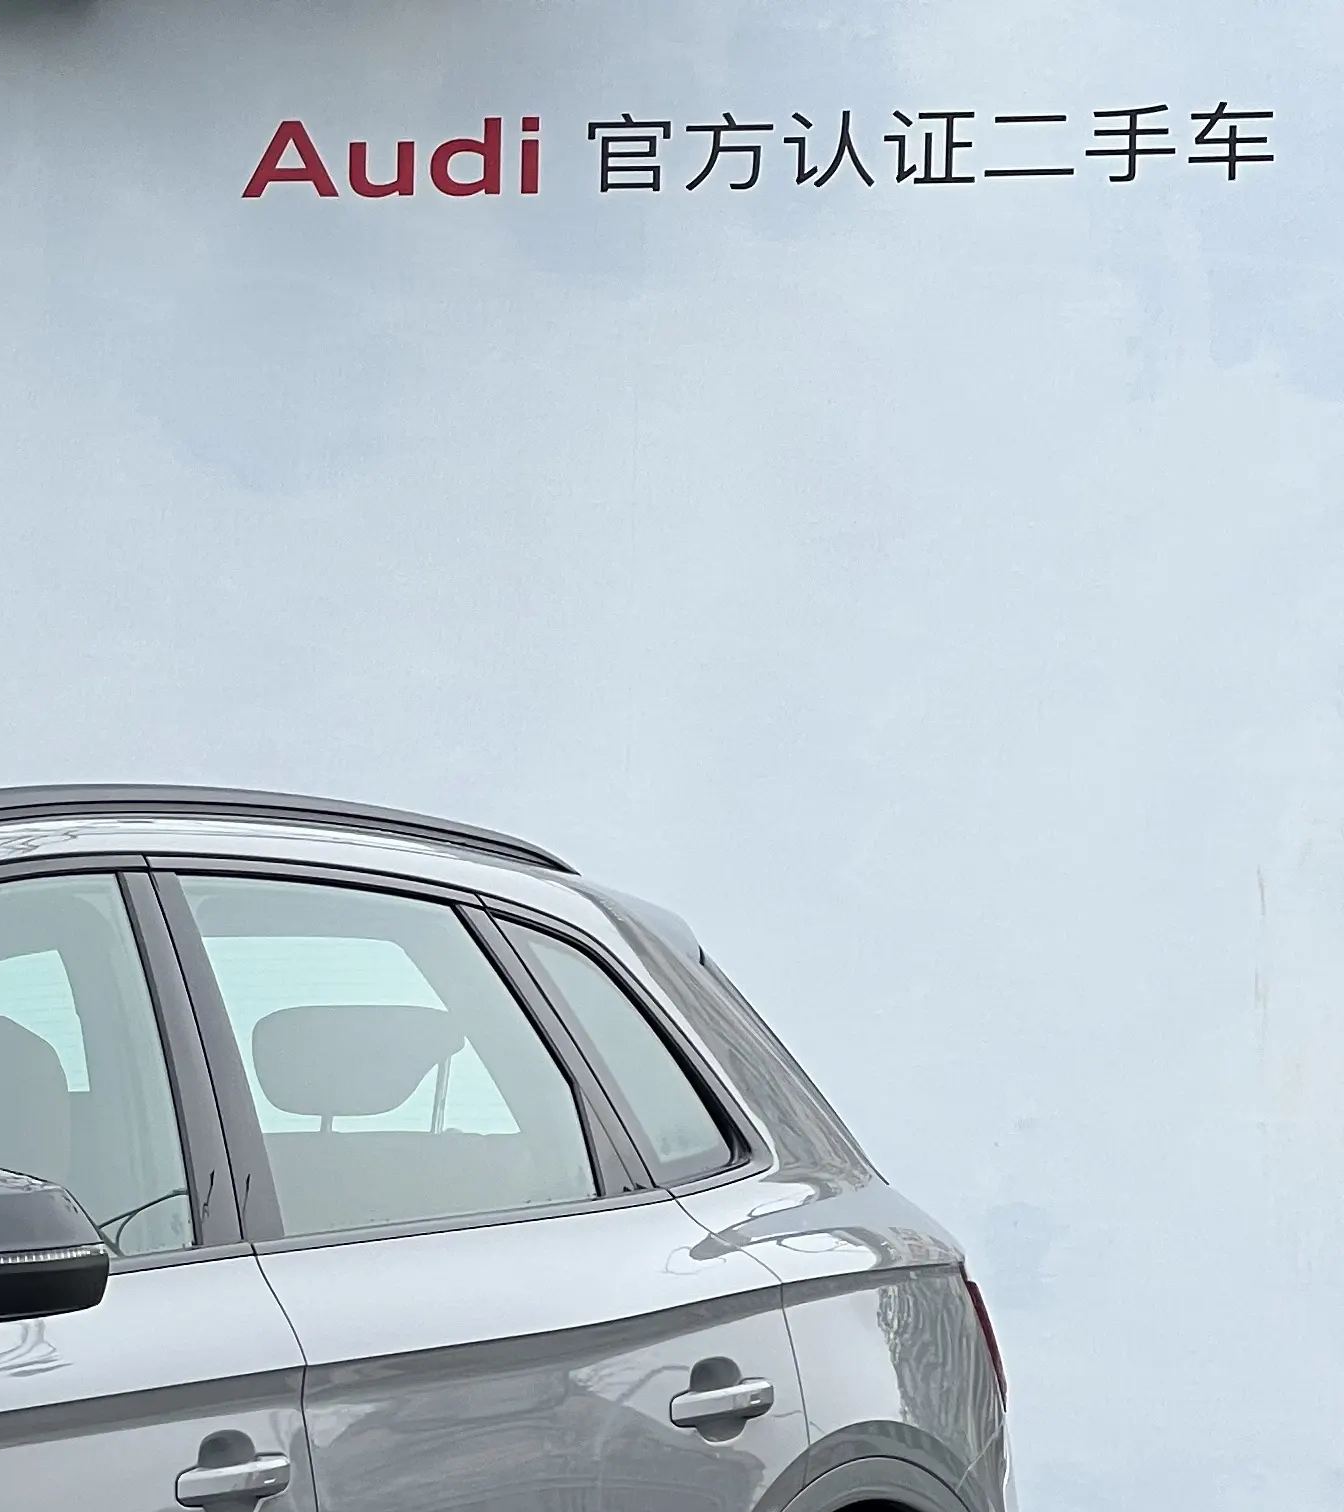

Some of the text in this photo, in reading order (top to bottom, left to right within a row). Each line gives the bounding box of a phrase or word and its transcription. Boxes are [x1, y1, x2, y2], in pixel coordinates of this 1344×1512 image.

[241, 100, 1276, 199] Audi 官方认证二手车
